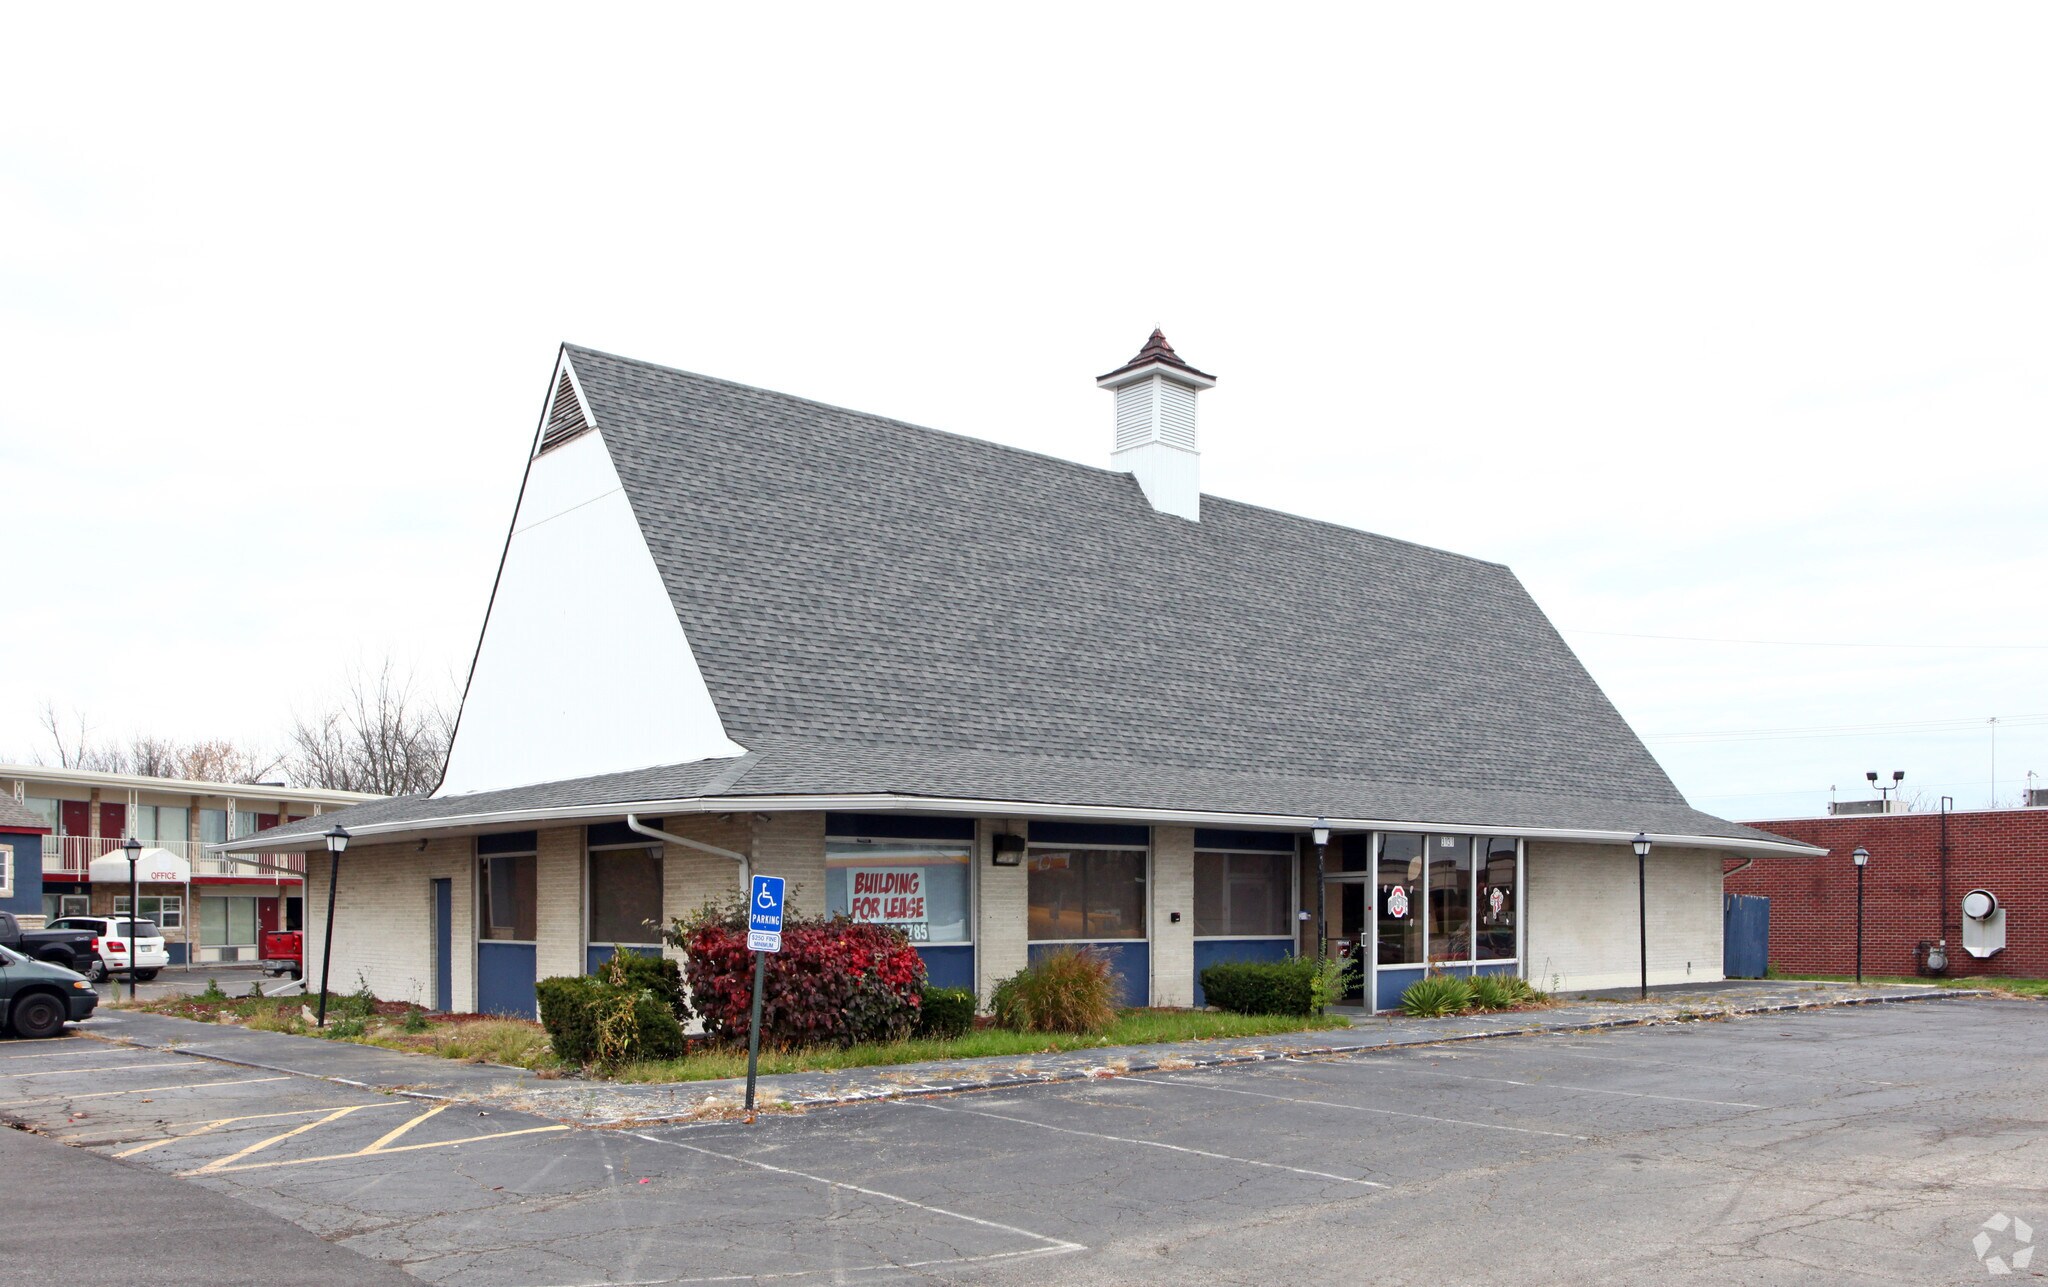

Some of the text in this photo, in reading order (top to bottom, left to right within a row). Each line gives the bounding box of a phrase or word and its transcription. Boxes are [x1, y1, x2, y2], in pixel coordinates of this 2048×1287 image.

[854, 872, 919, 895] BUILDING
[852, 897, 924, 919] FOR LEASE
[752, 914, 780, 926] PARKING
